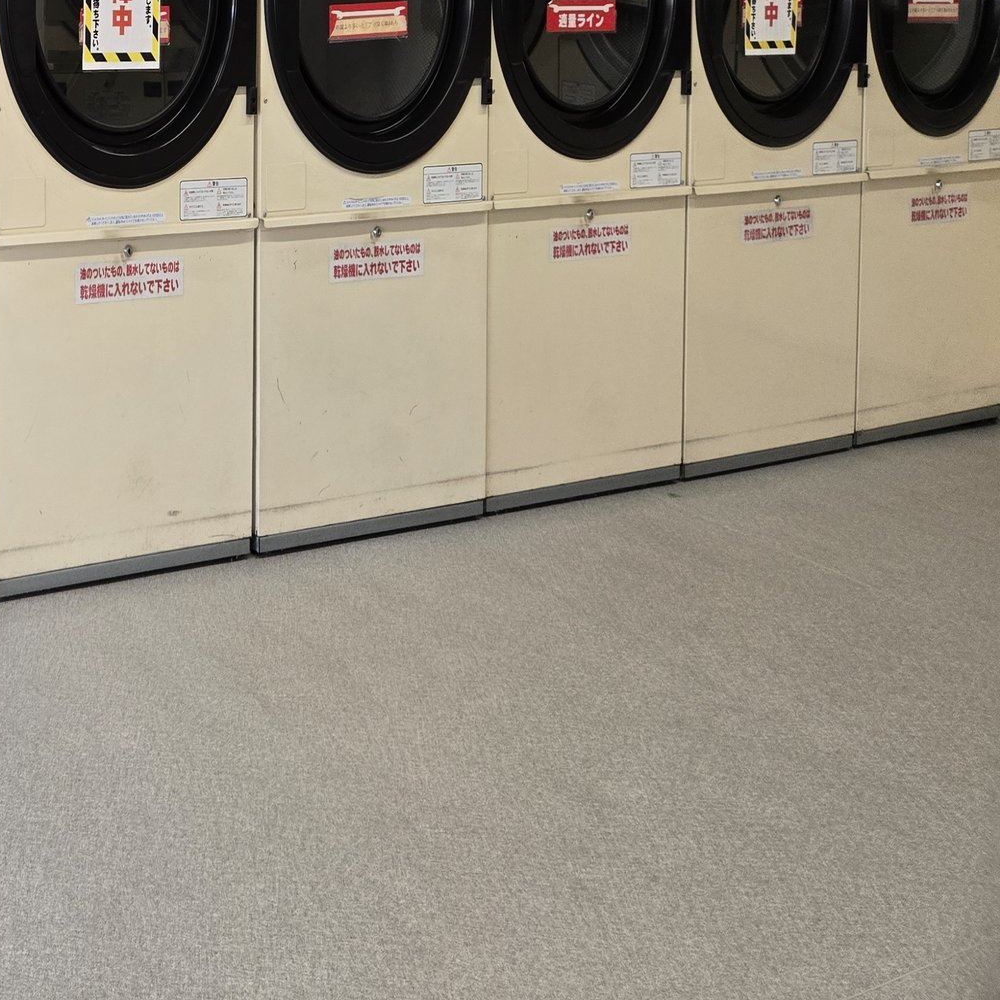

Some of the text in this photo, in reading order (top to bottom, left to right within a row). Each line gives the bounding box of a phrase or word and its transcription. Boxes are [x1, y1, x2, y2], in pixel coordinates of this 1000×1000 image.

[553, 240, 628, 259] 乾燥機に入れないで下さい
[333, 259, 420, 279] 乾燥機に入れないで下さい
[80, 278, 179, 300] 乾燥機に入れないで下さい
